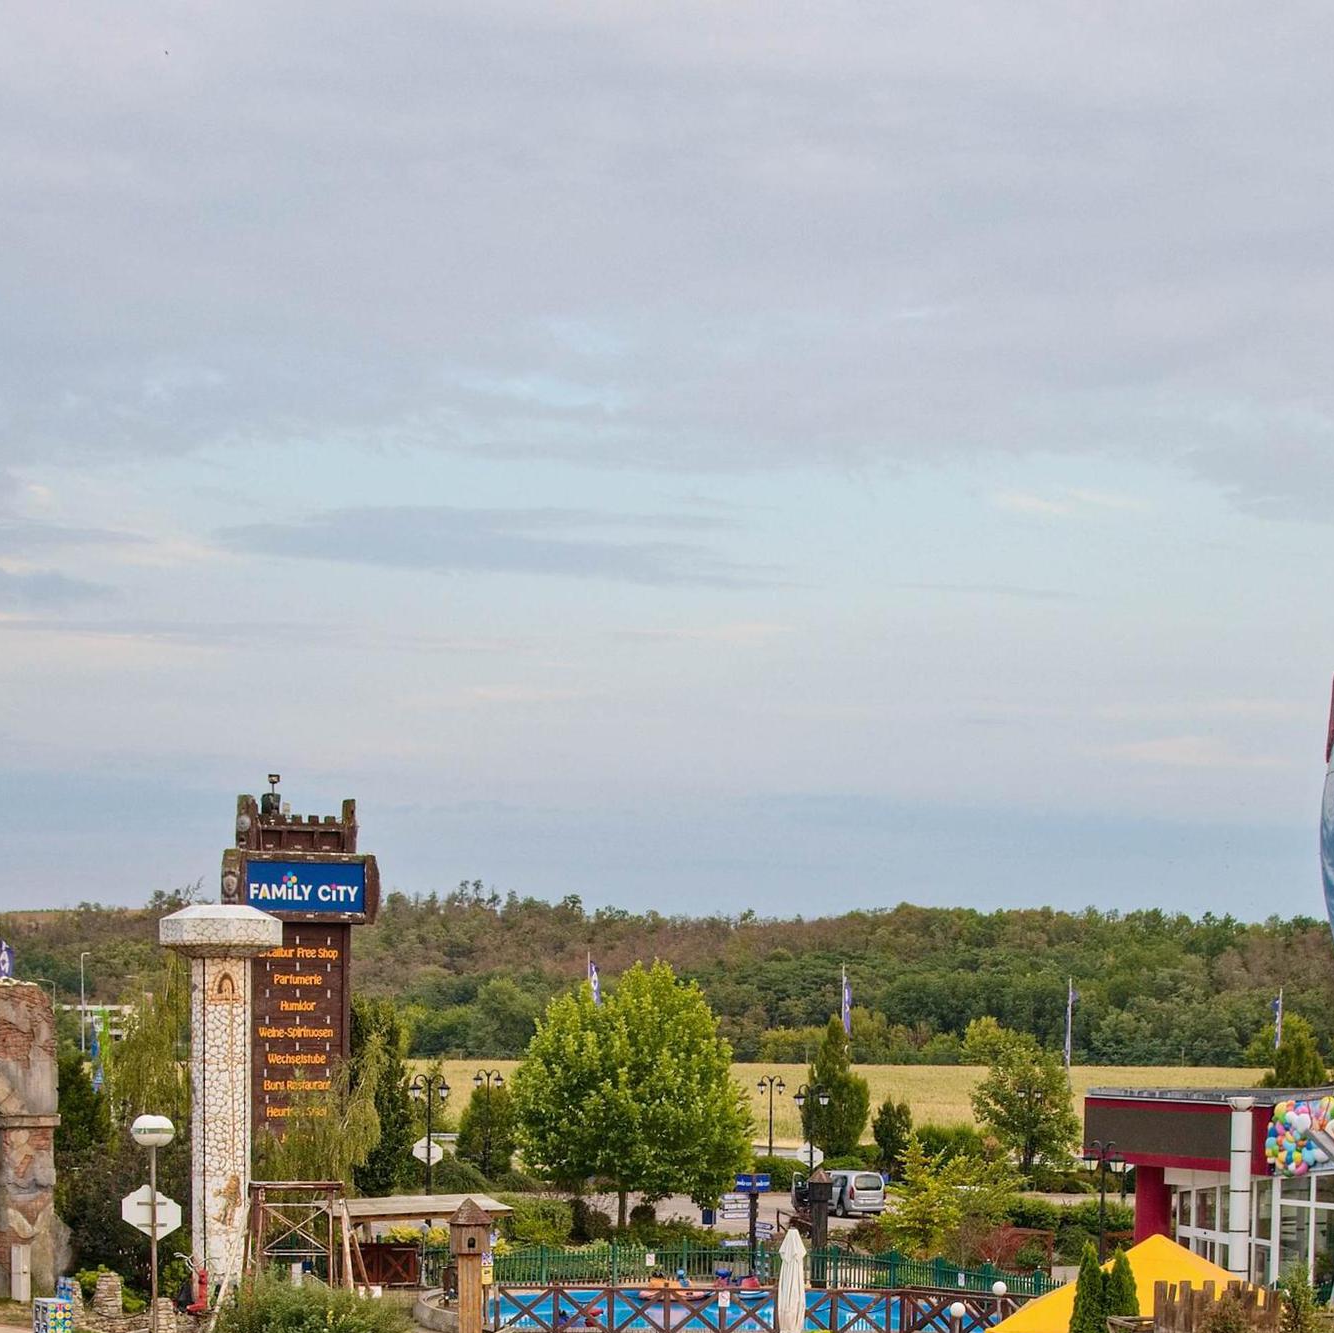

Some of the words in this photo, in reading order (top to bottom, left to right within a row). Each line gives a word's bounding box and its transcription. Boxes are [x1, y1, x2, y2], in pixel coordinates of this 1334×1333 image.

[297, 947, 317, 958] Free
[318, 947, 338, 960] Shop
[280, 1000, 316, 1011] Humidor
[267, 1053, 327, 1064] Wechselstube
